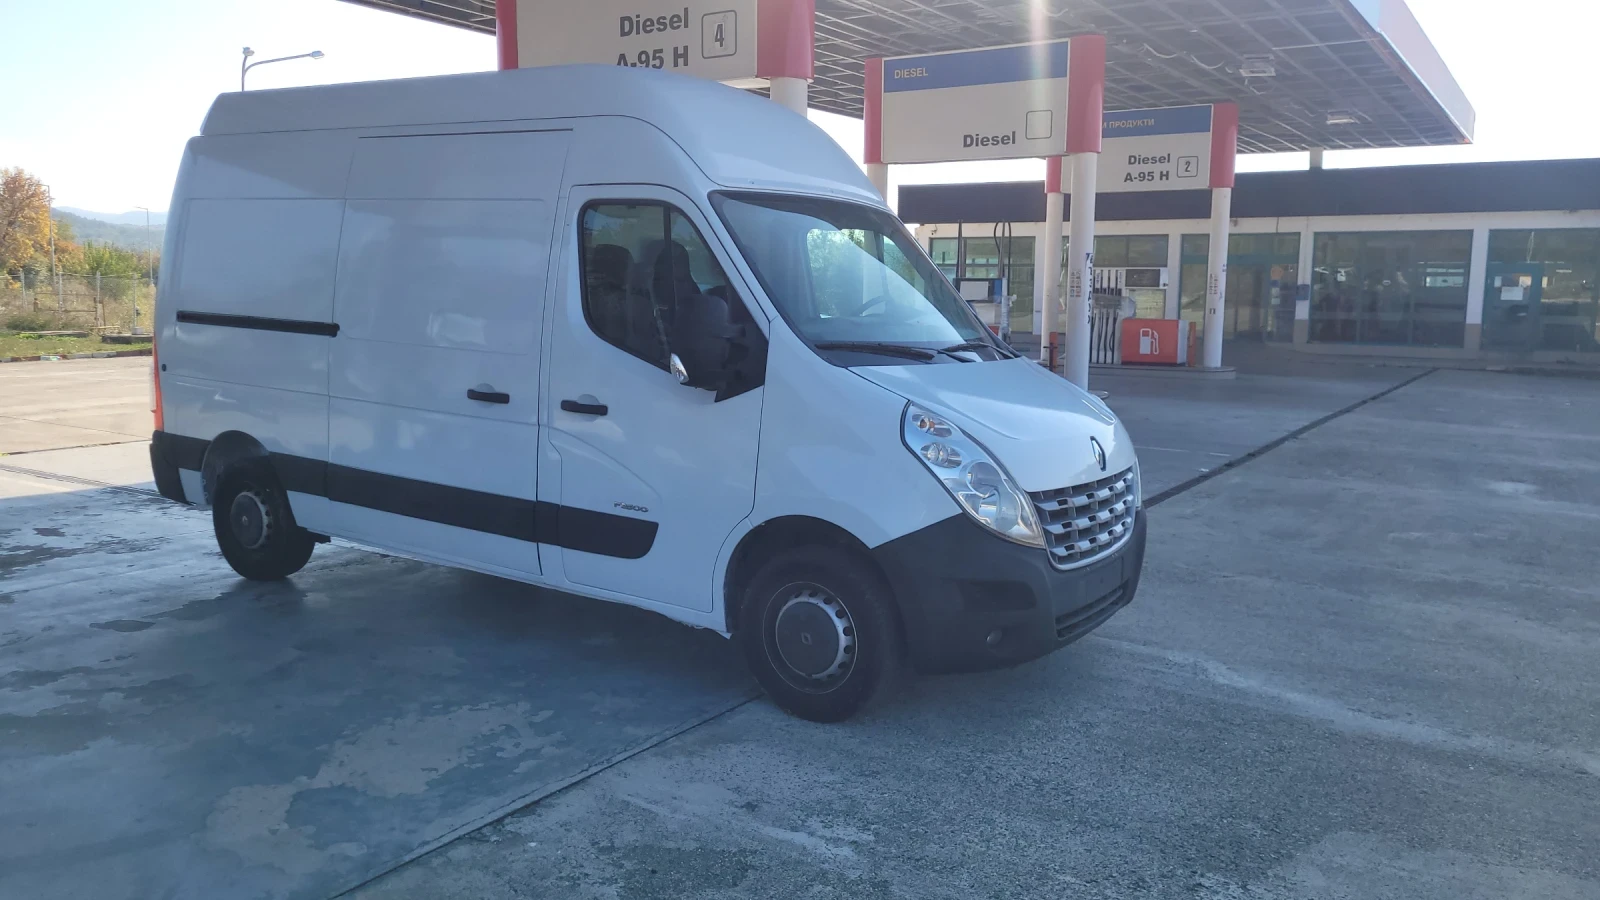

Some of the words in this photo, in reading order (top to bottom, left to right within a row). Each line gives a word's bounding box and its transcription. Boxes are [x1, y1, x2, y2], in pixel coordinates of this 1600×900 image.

[619, 7, 689, 37] Diesel
[714, 23, 725, 48] 4
[673, 45, 689, 68] H
[894, 67, 928, 79] DIESEL
[1109, 118, 1155, 129] ПРОДУКТИ
[963, 131, 1016, 148] Diesel
[1128, 153, 1171, 165] Diesel
[1184, 161, 1191, 173] 2
[1124, 171, 1155, 183] A-95
[1159, 170, 1170, 181] H
